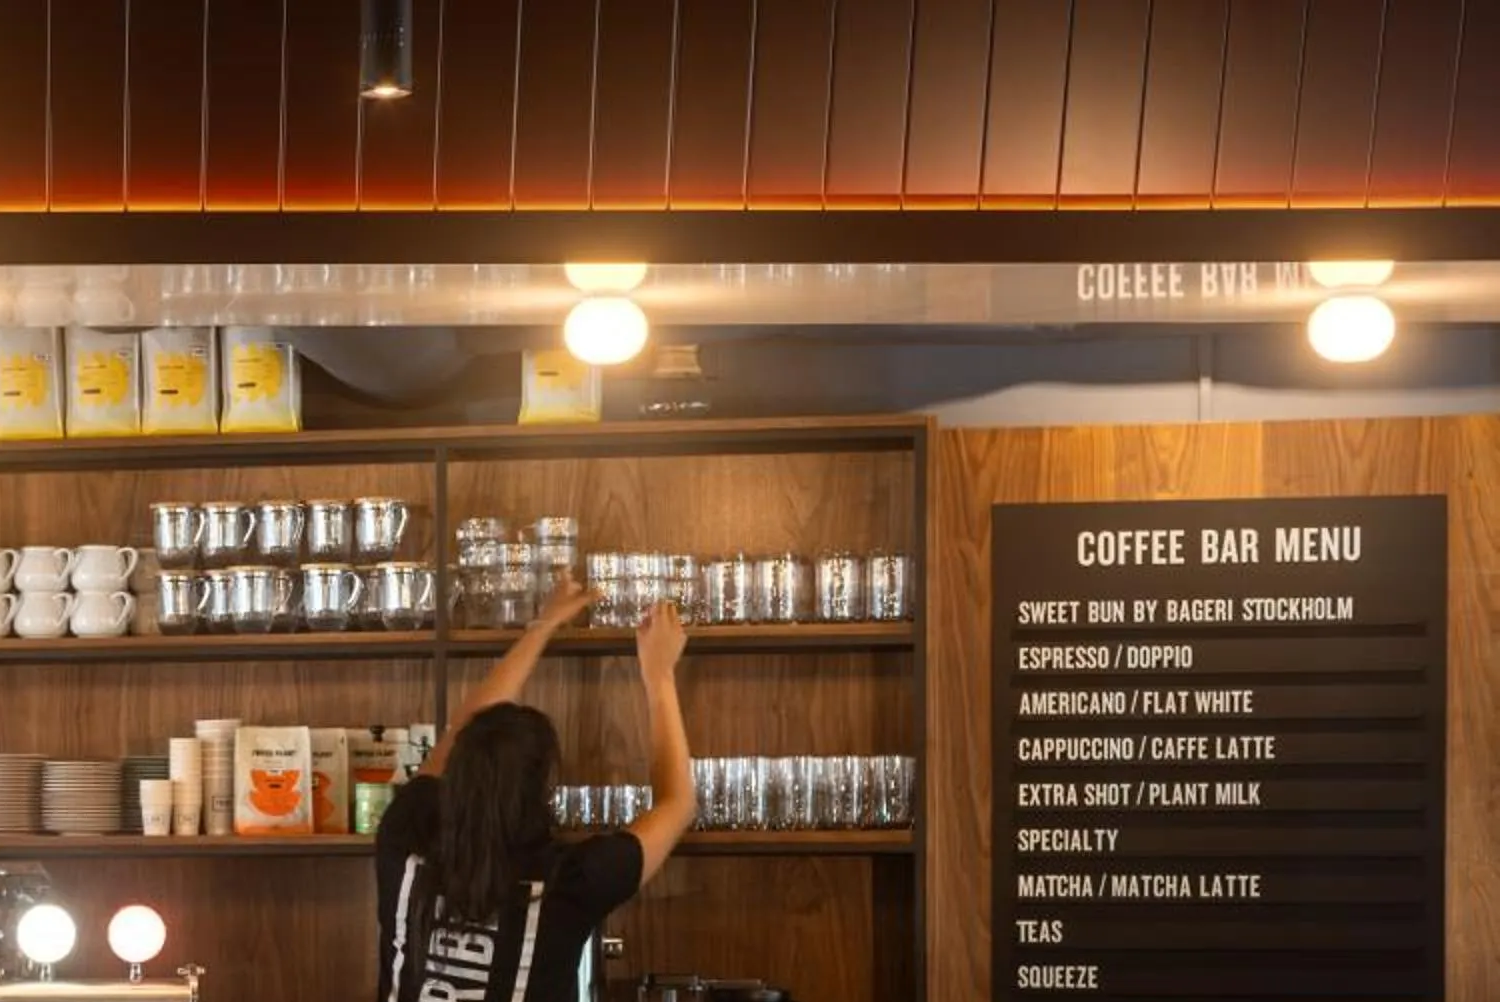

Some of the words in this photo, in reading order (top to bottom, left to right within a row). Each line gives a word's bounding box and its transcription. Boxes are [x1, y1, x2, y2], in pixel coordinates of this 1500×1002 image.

[1078, 530, 1184, 566] COFFEE
[1202, 529, 1258, 563] BAR
[1276, 526, 1360, 562] MENU
[1019, 601, 1080, 624] SWEET
[1088, 601, 1124, 623] BUN
[1134, 600, 1157, 622] BY
[1167, 599, 1232, 622] BAGERI
[1242, 597, 1353, 621] STOCKHOLM
[1019, 646, 1109, 669] ESPRESSO
[1127, 645, 1192, 668] DOPPIO
[1020, 692, 1125, 714] AMERICANO
[1143, 691, 1188, 714] FLAT
[1195, 690, 1252, 713] WHITE
[1019, 738, 1133, 760] CAPPUCCINO
[1152, 737, 1208, 760] CAFFE
[1216, 736, 1275, 759] LATTE
[1019, 784, 1078, 806] EXTRA
[1084, 784, 1131, 806] SHOT
[1149, 783, 1208, 805] PLANT
[1216, 783, 1260, 805] MILK
[1018, 829, 1118, 851] SPECIALTY
[1019, 875, 1092, 897] MATCHA
[1112, 875, 1191, 897] MATCHA
[1200, 875, 1260, 897] LATTE
[1016, 920, 1062, 942] TEAS
[1018, 966, 1098, 988] SQUEEZE
